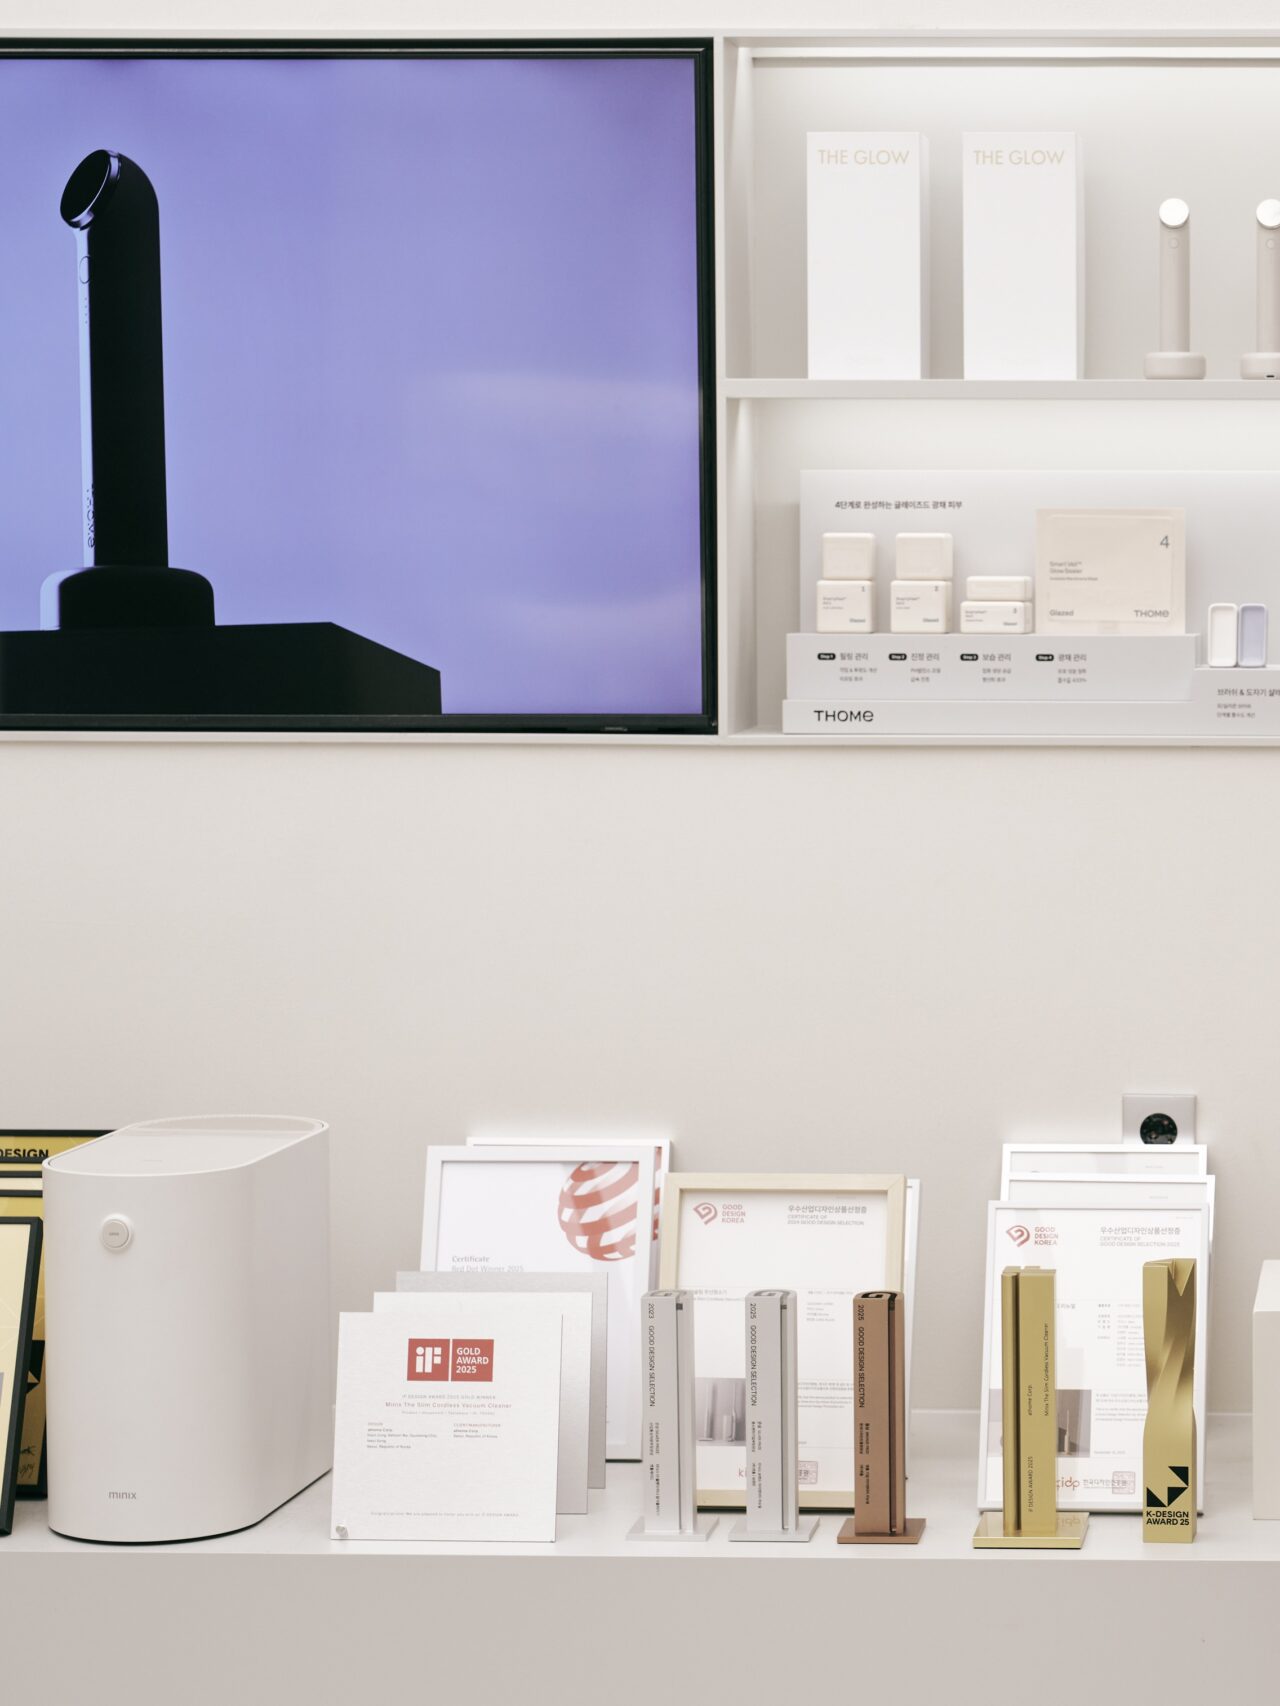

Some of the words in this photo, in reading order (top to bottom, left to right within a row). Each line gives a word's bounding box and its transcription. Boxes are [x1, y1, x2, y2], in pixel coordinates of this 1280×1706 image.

[818, 149, 848, 165] THE
[854, 149, 911, 165] GLOW
[974, 150, 1004, 165] THE
[1009, 149, 1065, 165] GLOW
[1160, 535, 1170, 549] 4
[1049, 609, 1074, 617] Glazed
[1217, 688, 1237, 697] 브러쉬
[1246, 688, 1267, 697] 도자기
[813, 710, 874, 722] THOMe
[451, 1255, 490, 1263] Certificate
[648, 1303, 656, 1319] 2023
[648, 1325, 656, 1345] GOOD
[456, 1347, 481, 1355] GOLD
[456, 1356, 490, 1364] AWARD
[648, 1346, 656, 1371] DESIGN
[456, 1365, 477, 1374] 2025
[648, 1372, 656, 1407] SELECTION
[432, 1401, 460, 1409] Cordless
[1146, 1510, 1189, 1518] K-DESIGN
[1179, 1518, 1190, 1526] 25
